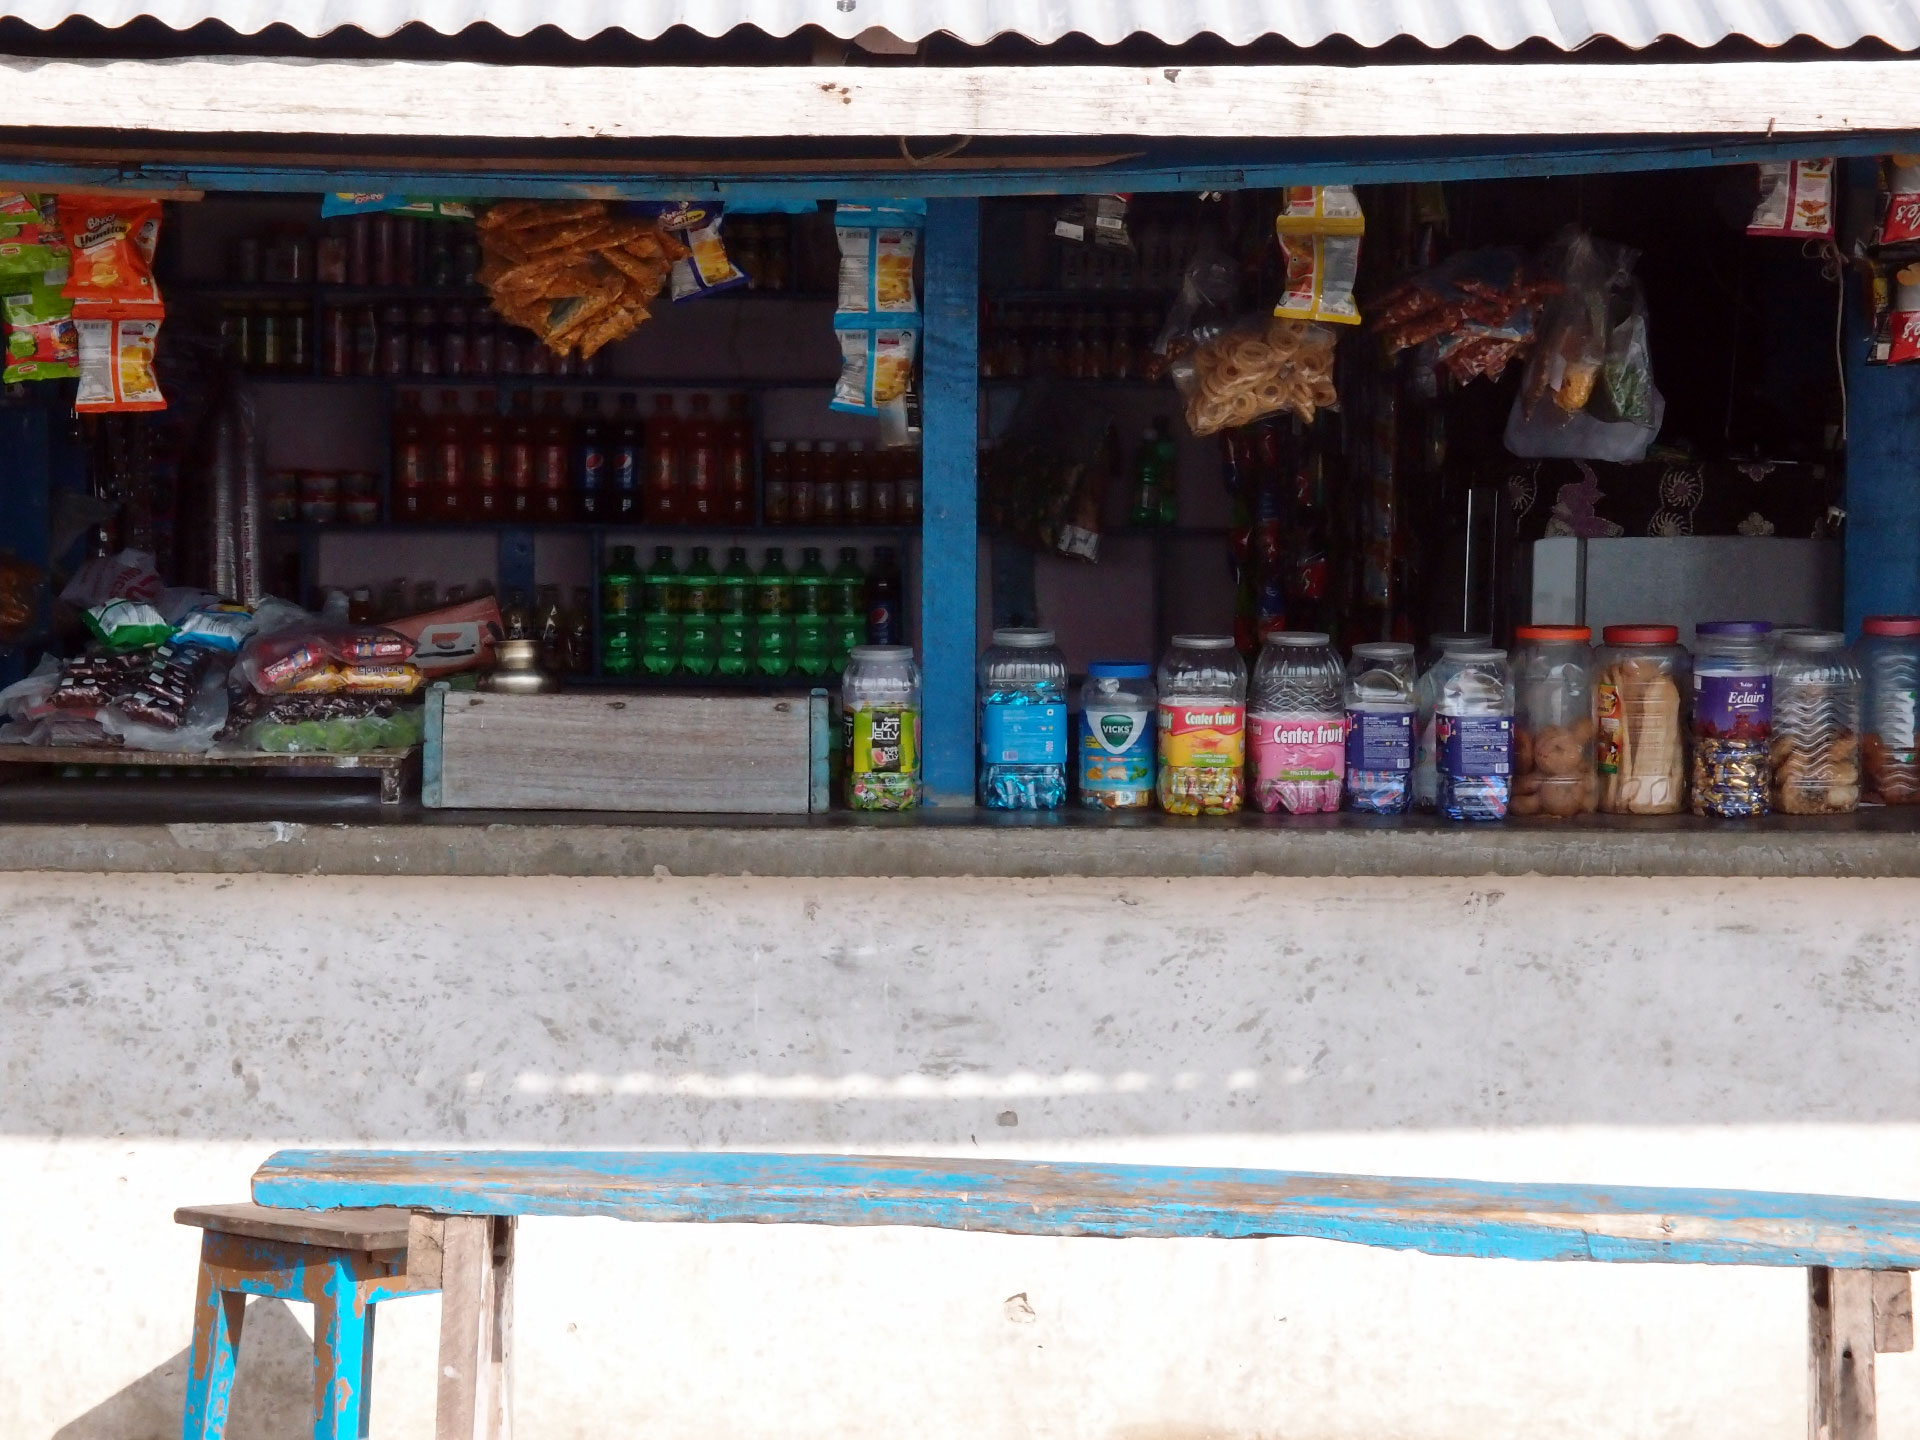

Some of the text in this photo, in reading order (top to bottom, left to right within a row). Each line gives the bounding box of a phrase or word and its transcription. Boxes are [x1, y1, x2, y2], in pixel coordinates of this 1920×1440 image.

[1728, 691, 1765, 704] Eclairs
[1185, 711, 1213, 725] Center
[1214, 711, 1236, 726] fruit
[871, 721, 900, 732] JUZT
[1102, 725, 1131, 734] VICKS
[867, 731, 900, 740] JELLY
[1273, 724, 1315, 744] Center
[1316, 724, 1344, 744] fruit
